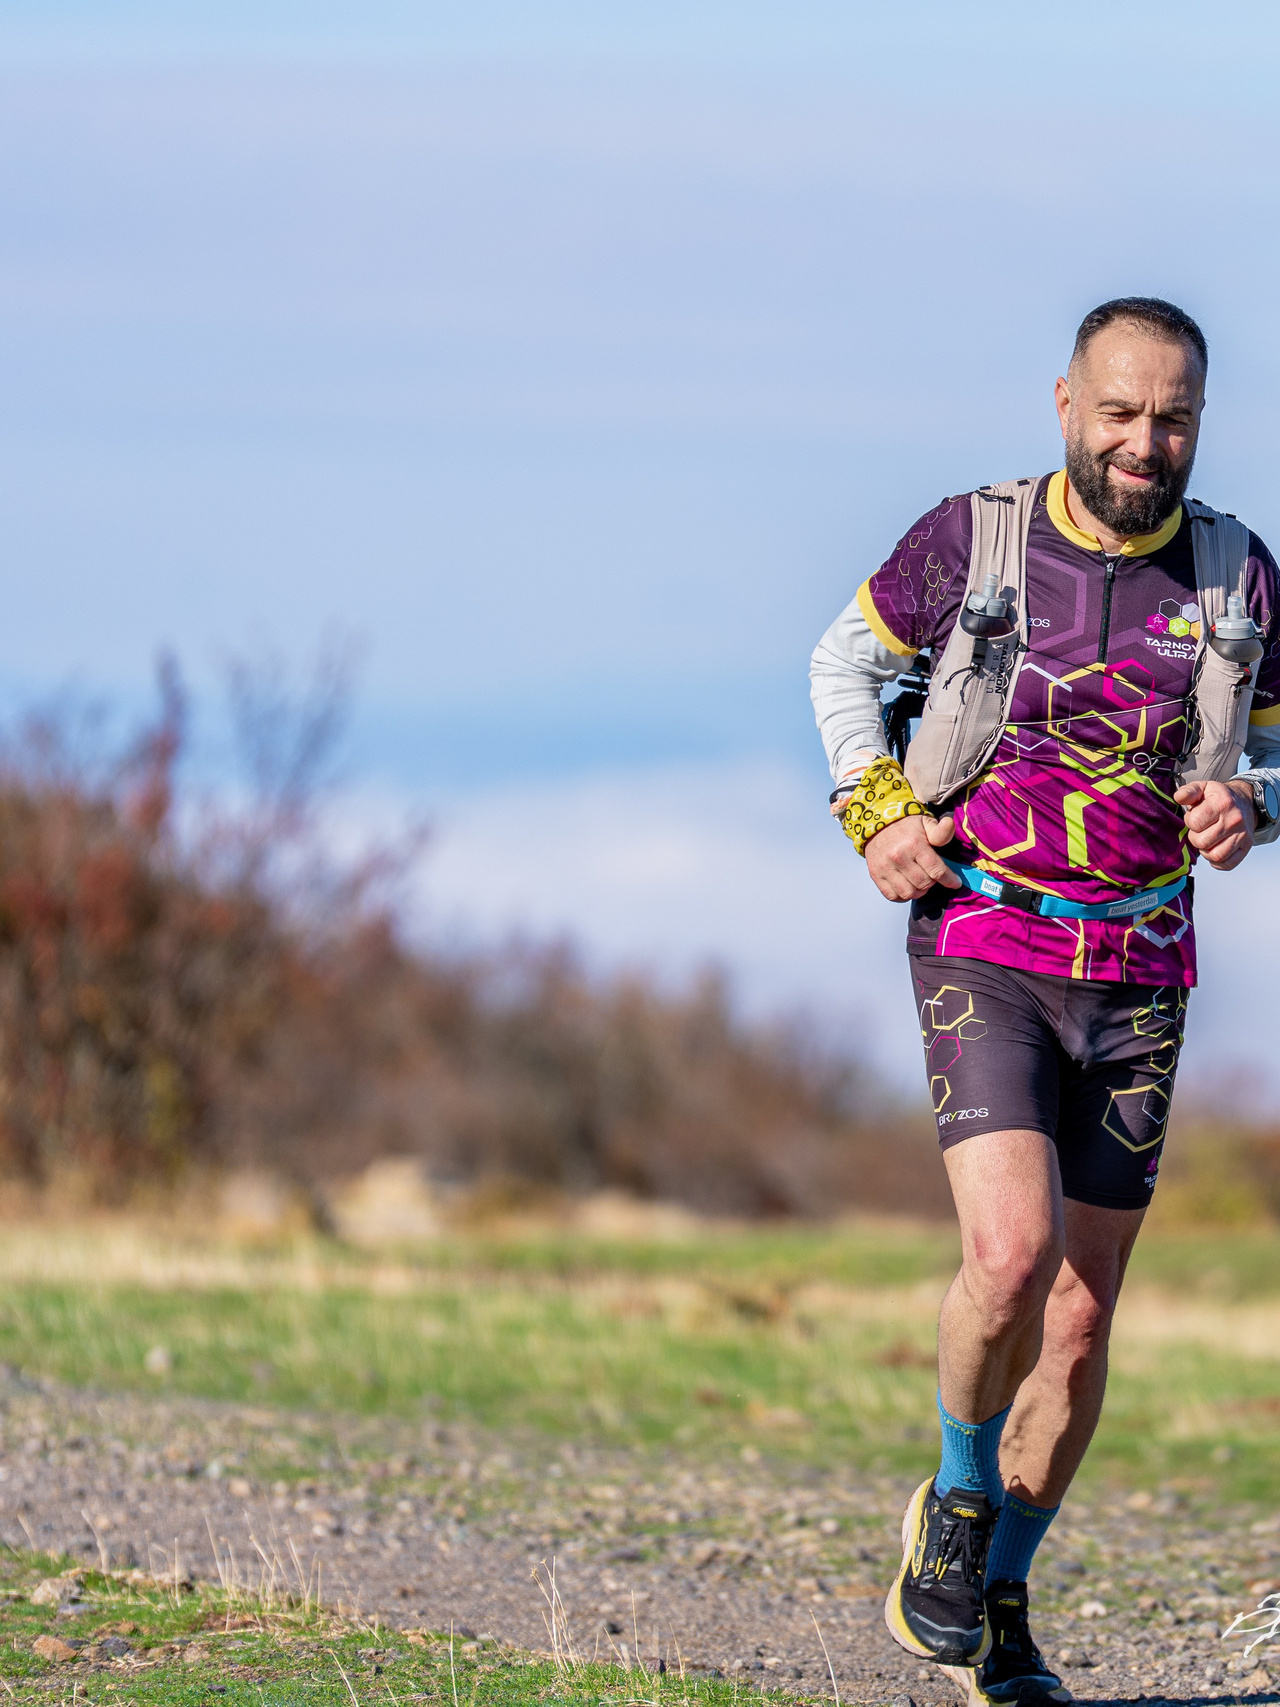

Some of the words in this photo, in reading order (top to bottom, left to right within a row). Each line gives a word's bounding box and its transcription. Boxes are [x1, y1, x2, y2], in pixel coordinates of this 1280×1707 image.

[1157, 648, 1196, 661] ULTRA
[995, 643, 1009, 694] SALOMON
[939, 1107, 989, 1127] BRYZOS
